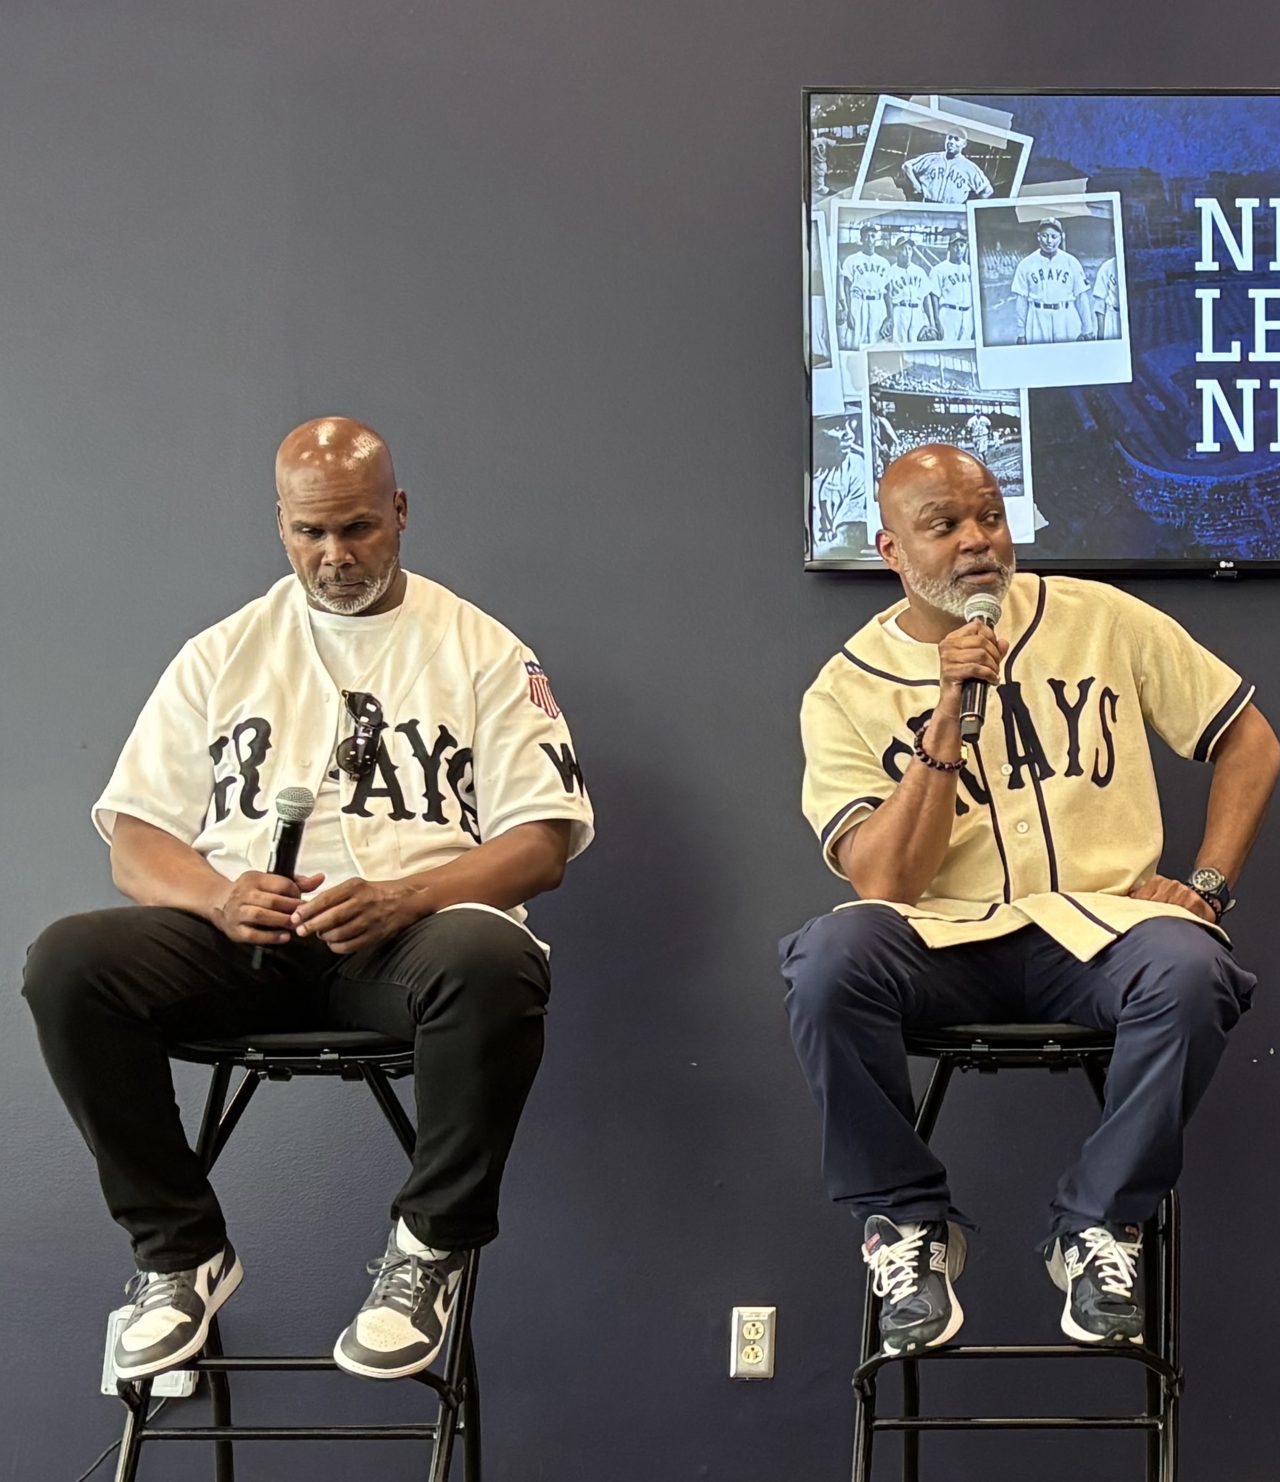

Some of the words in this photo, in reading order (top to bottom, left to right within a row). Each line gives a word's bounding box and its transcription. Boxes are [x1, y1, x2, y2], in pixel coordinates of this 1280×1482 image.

[929, 167, 966, 189] GRAYS
[1030, 268, 1070, 285] GRAYS
[882, 676, 1120, 816] AYS
